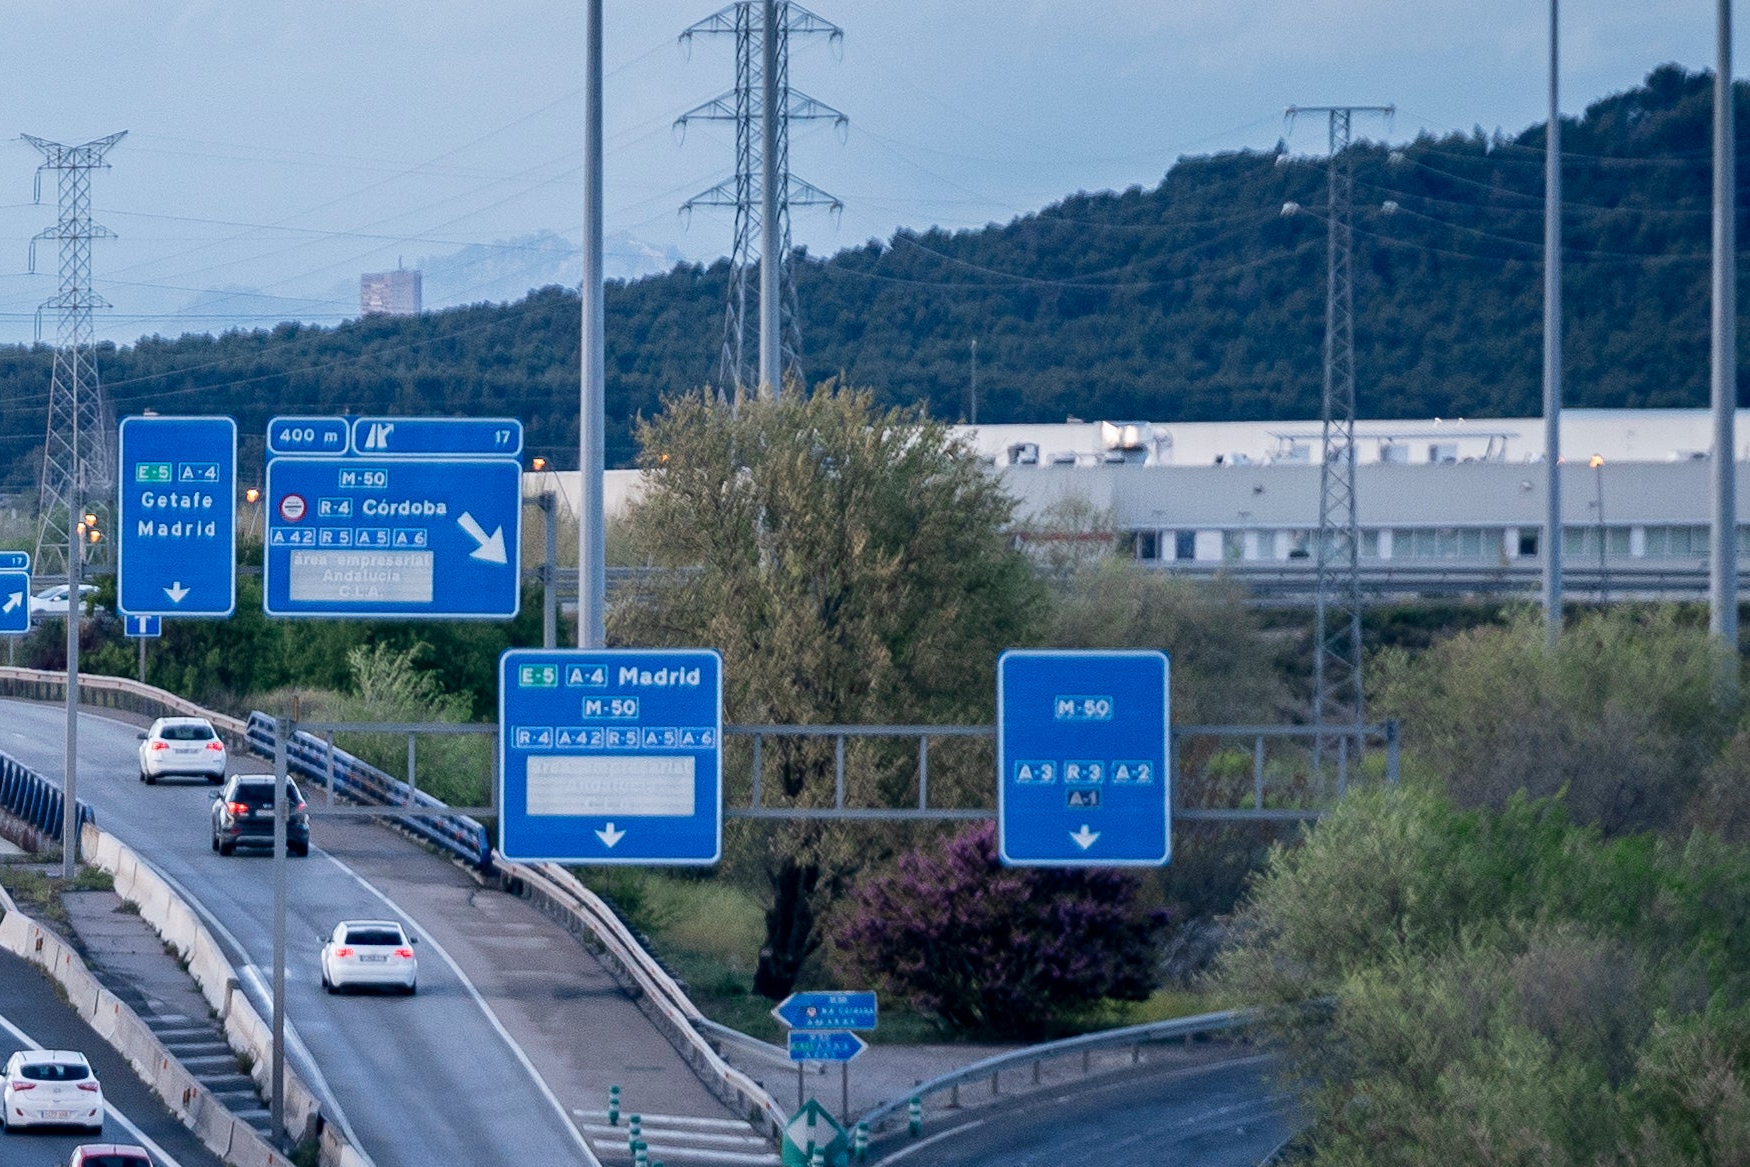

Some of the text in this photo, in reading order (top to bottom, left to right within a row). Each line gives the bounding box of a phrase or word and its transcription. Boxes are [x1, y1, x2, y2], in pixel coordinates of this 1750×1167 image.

[279, 428, 339, 443] 400 m
[495, 430, 510, 444] 17
[138, 465, 170, 481] E-5
[181, 465, 217, 481] A-4
[342, 470, 385, 486] M-50
[141, 492, 214, 509] Getafe
[320, 500, 350, 515] R-4
[362, 497, 447, 516] Córdoba
[138, 520, 216, 537] Madrid
[11, 557, 23, 565] 17
[522, 667, 555, 684] E-5
[570, 666, 701, 686] A-4 Madrid
[585, 700, 636, 716] M-50
[1057, 699, 1109, 718] M-50
[1017, 764, 1053, 781] A-3
[1066, 764, 1101, 781] R-3
[1115, 764, 1150, 781] A-2
[1068, 792, 1097, 805] A-1
